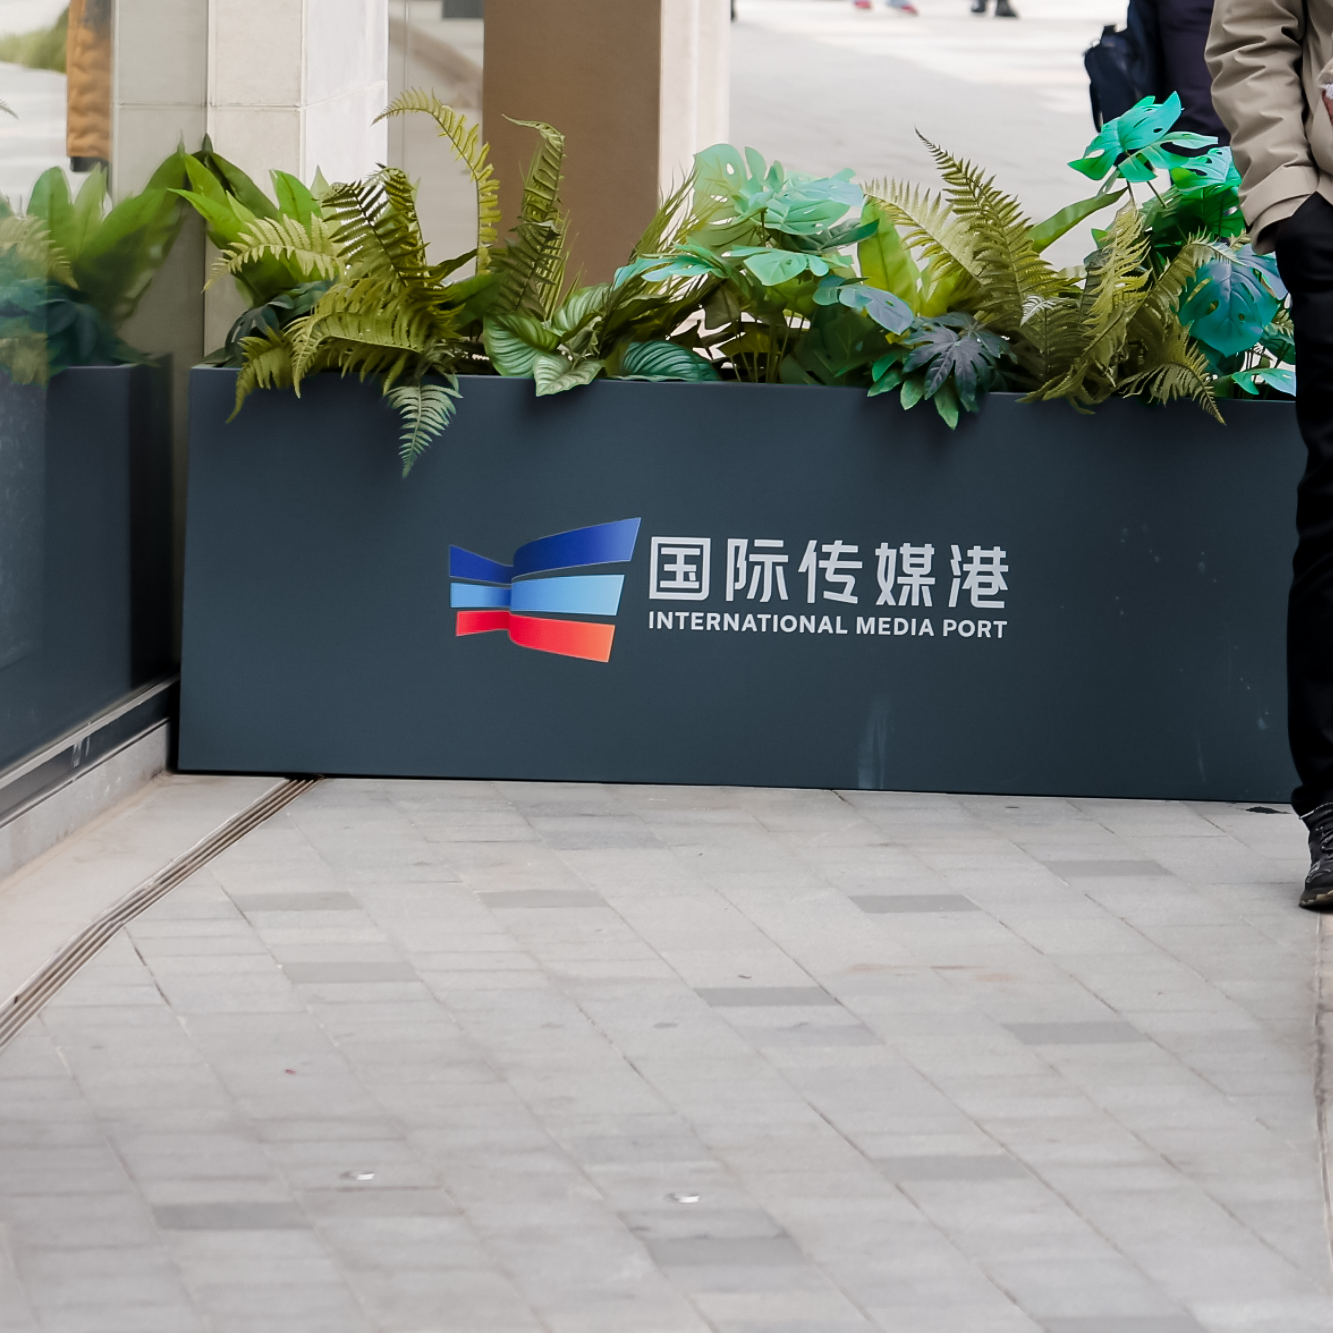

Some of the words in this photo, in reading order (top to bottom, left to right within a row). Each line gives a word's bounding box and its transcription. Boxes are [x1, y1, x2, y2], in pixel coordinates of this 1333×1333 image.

[649, 536, 1009, 609] 国际传媒港
[649, 611, 848, 635] INTERNATIONAL
[856, 616, 935, 637] MEDIA
[942, 618, 1008, 639] PORT
